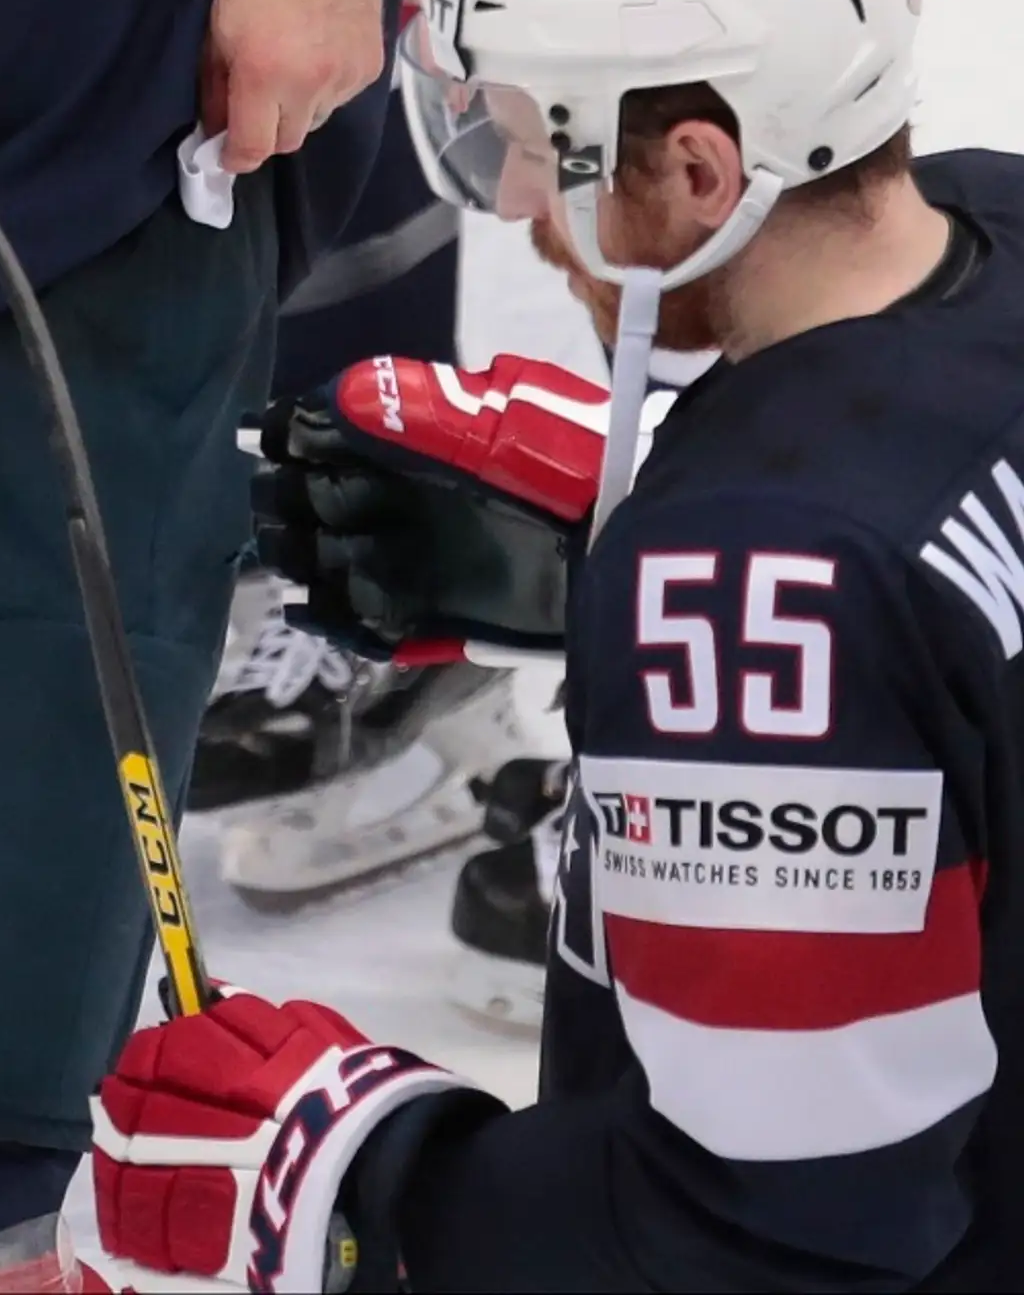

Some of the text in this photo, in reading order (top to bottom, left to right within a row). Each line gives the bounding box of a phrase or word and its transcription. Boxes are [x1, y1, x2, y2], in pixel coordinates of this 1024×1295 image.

[373, 355, 405, 434] CCM
[637, 551, 837, 739] 55
[128, 781, 182, 928] CCM
[655, 798, 927, 857] TISSOT
[603, 850, 922, 892] SWISS WATCHES SINCE 1853
